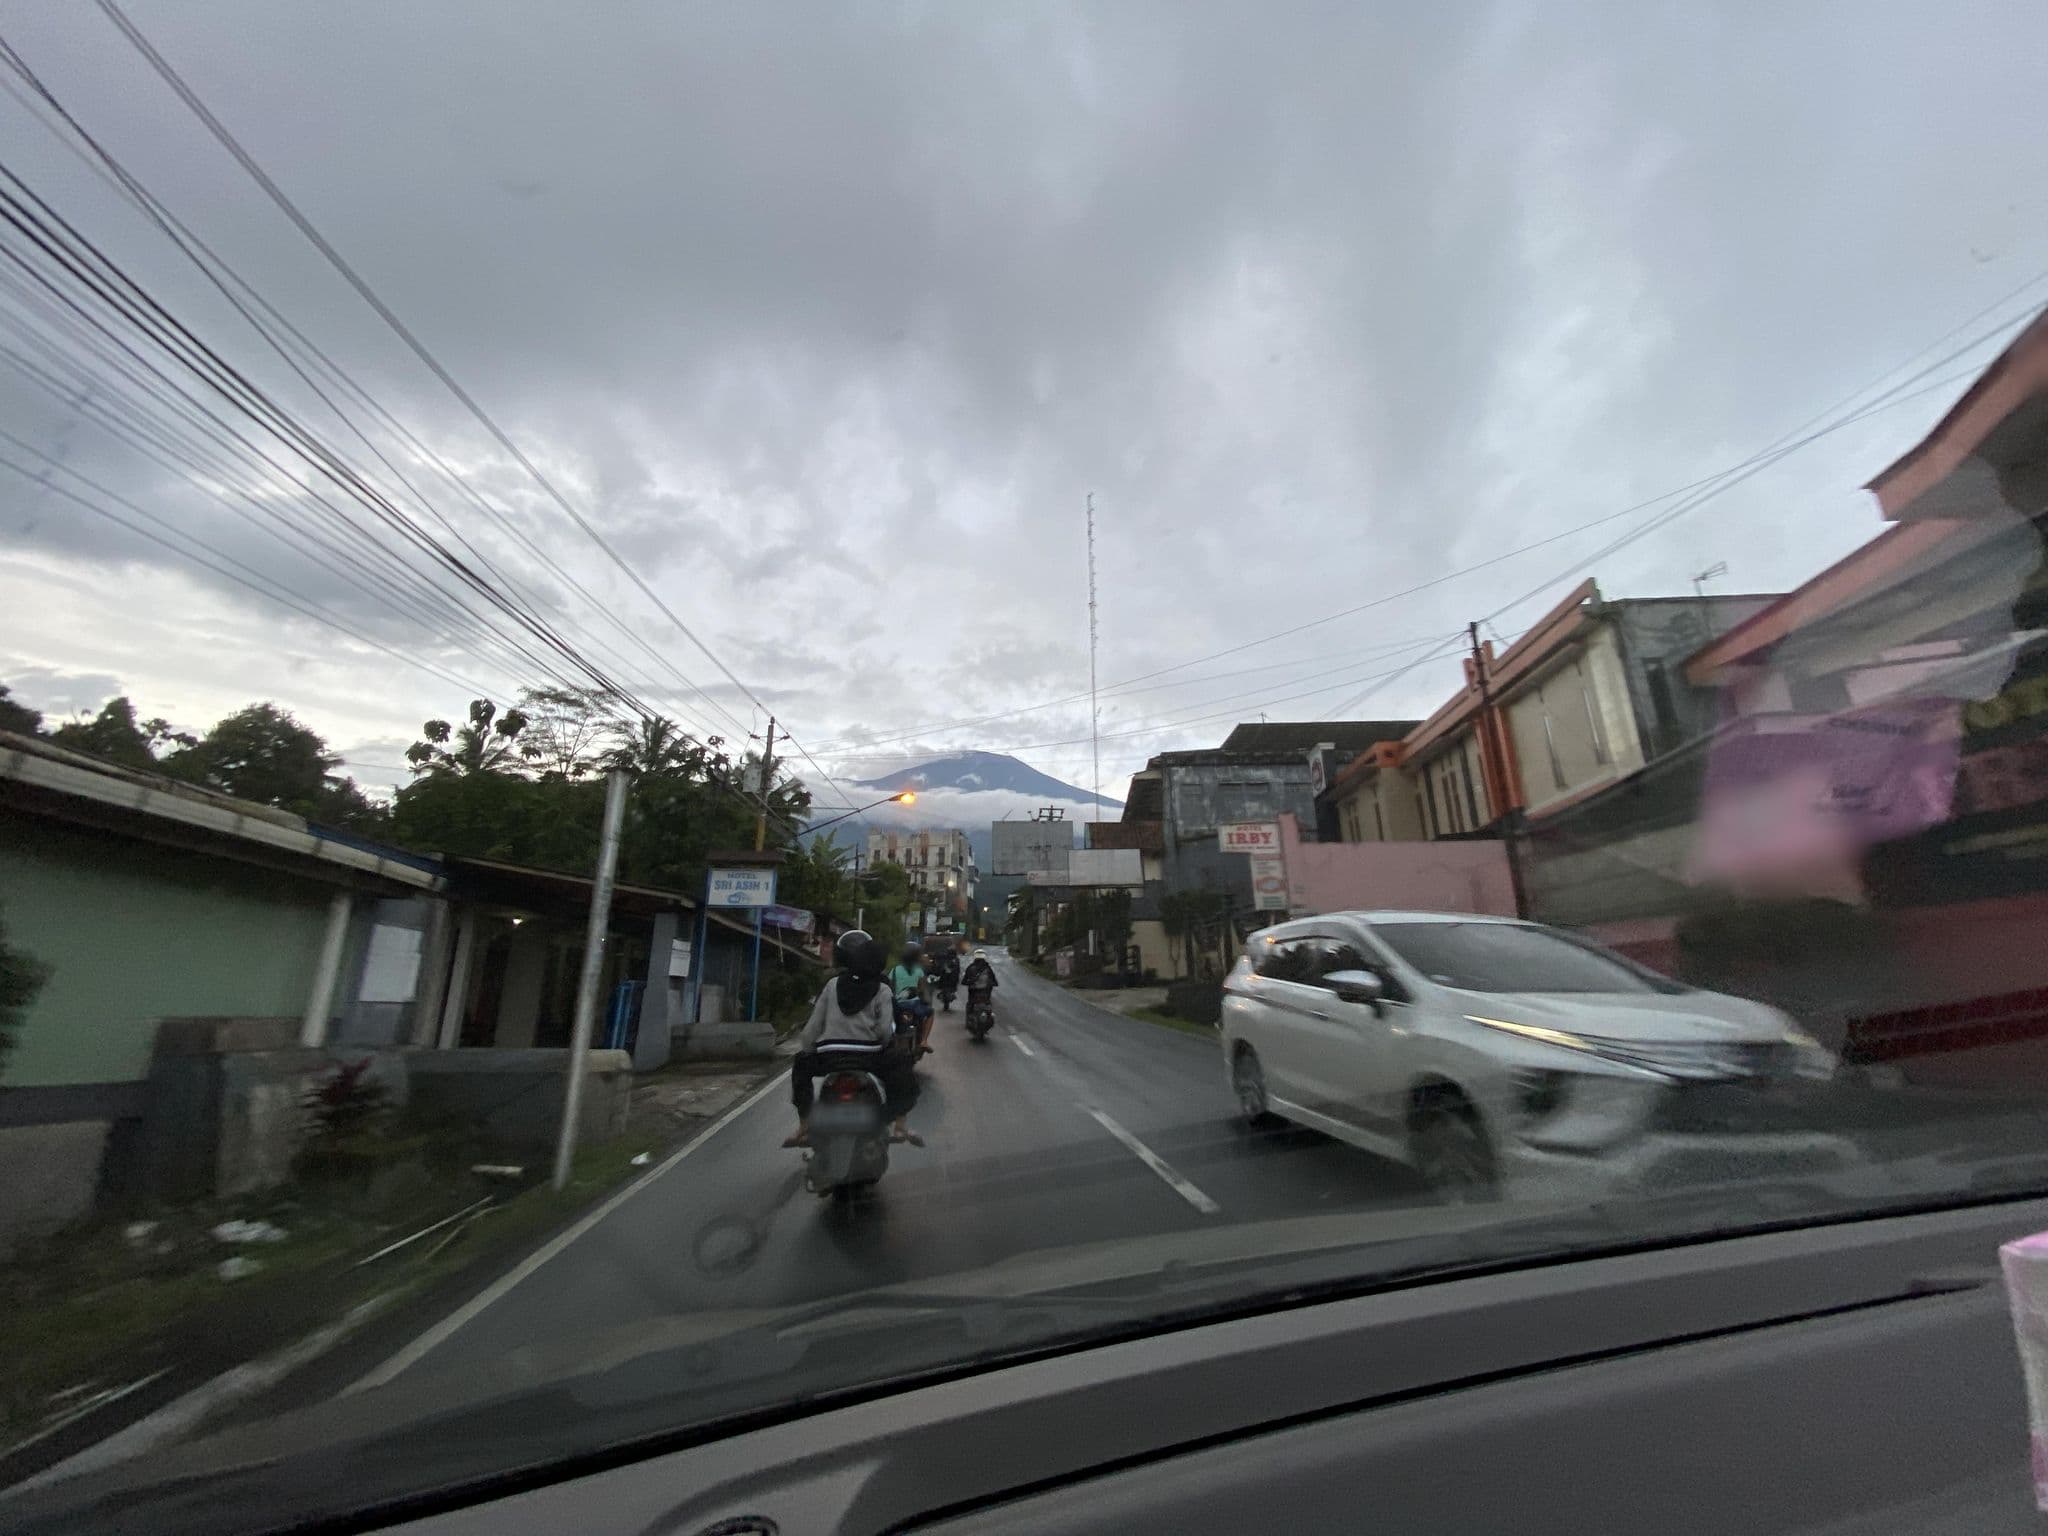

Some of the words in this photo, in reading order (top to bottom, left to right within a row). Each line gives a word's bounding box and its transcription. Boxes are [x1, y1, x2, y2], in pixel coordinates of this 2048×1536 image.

[1226, 832, 1272, 845] IRBY
[713, 880, 732, 890] SRI
[735, 879, 761, 891] ASIH
